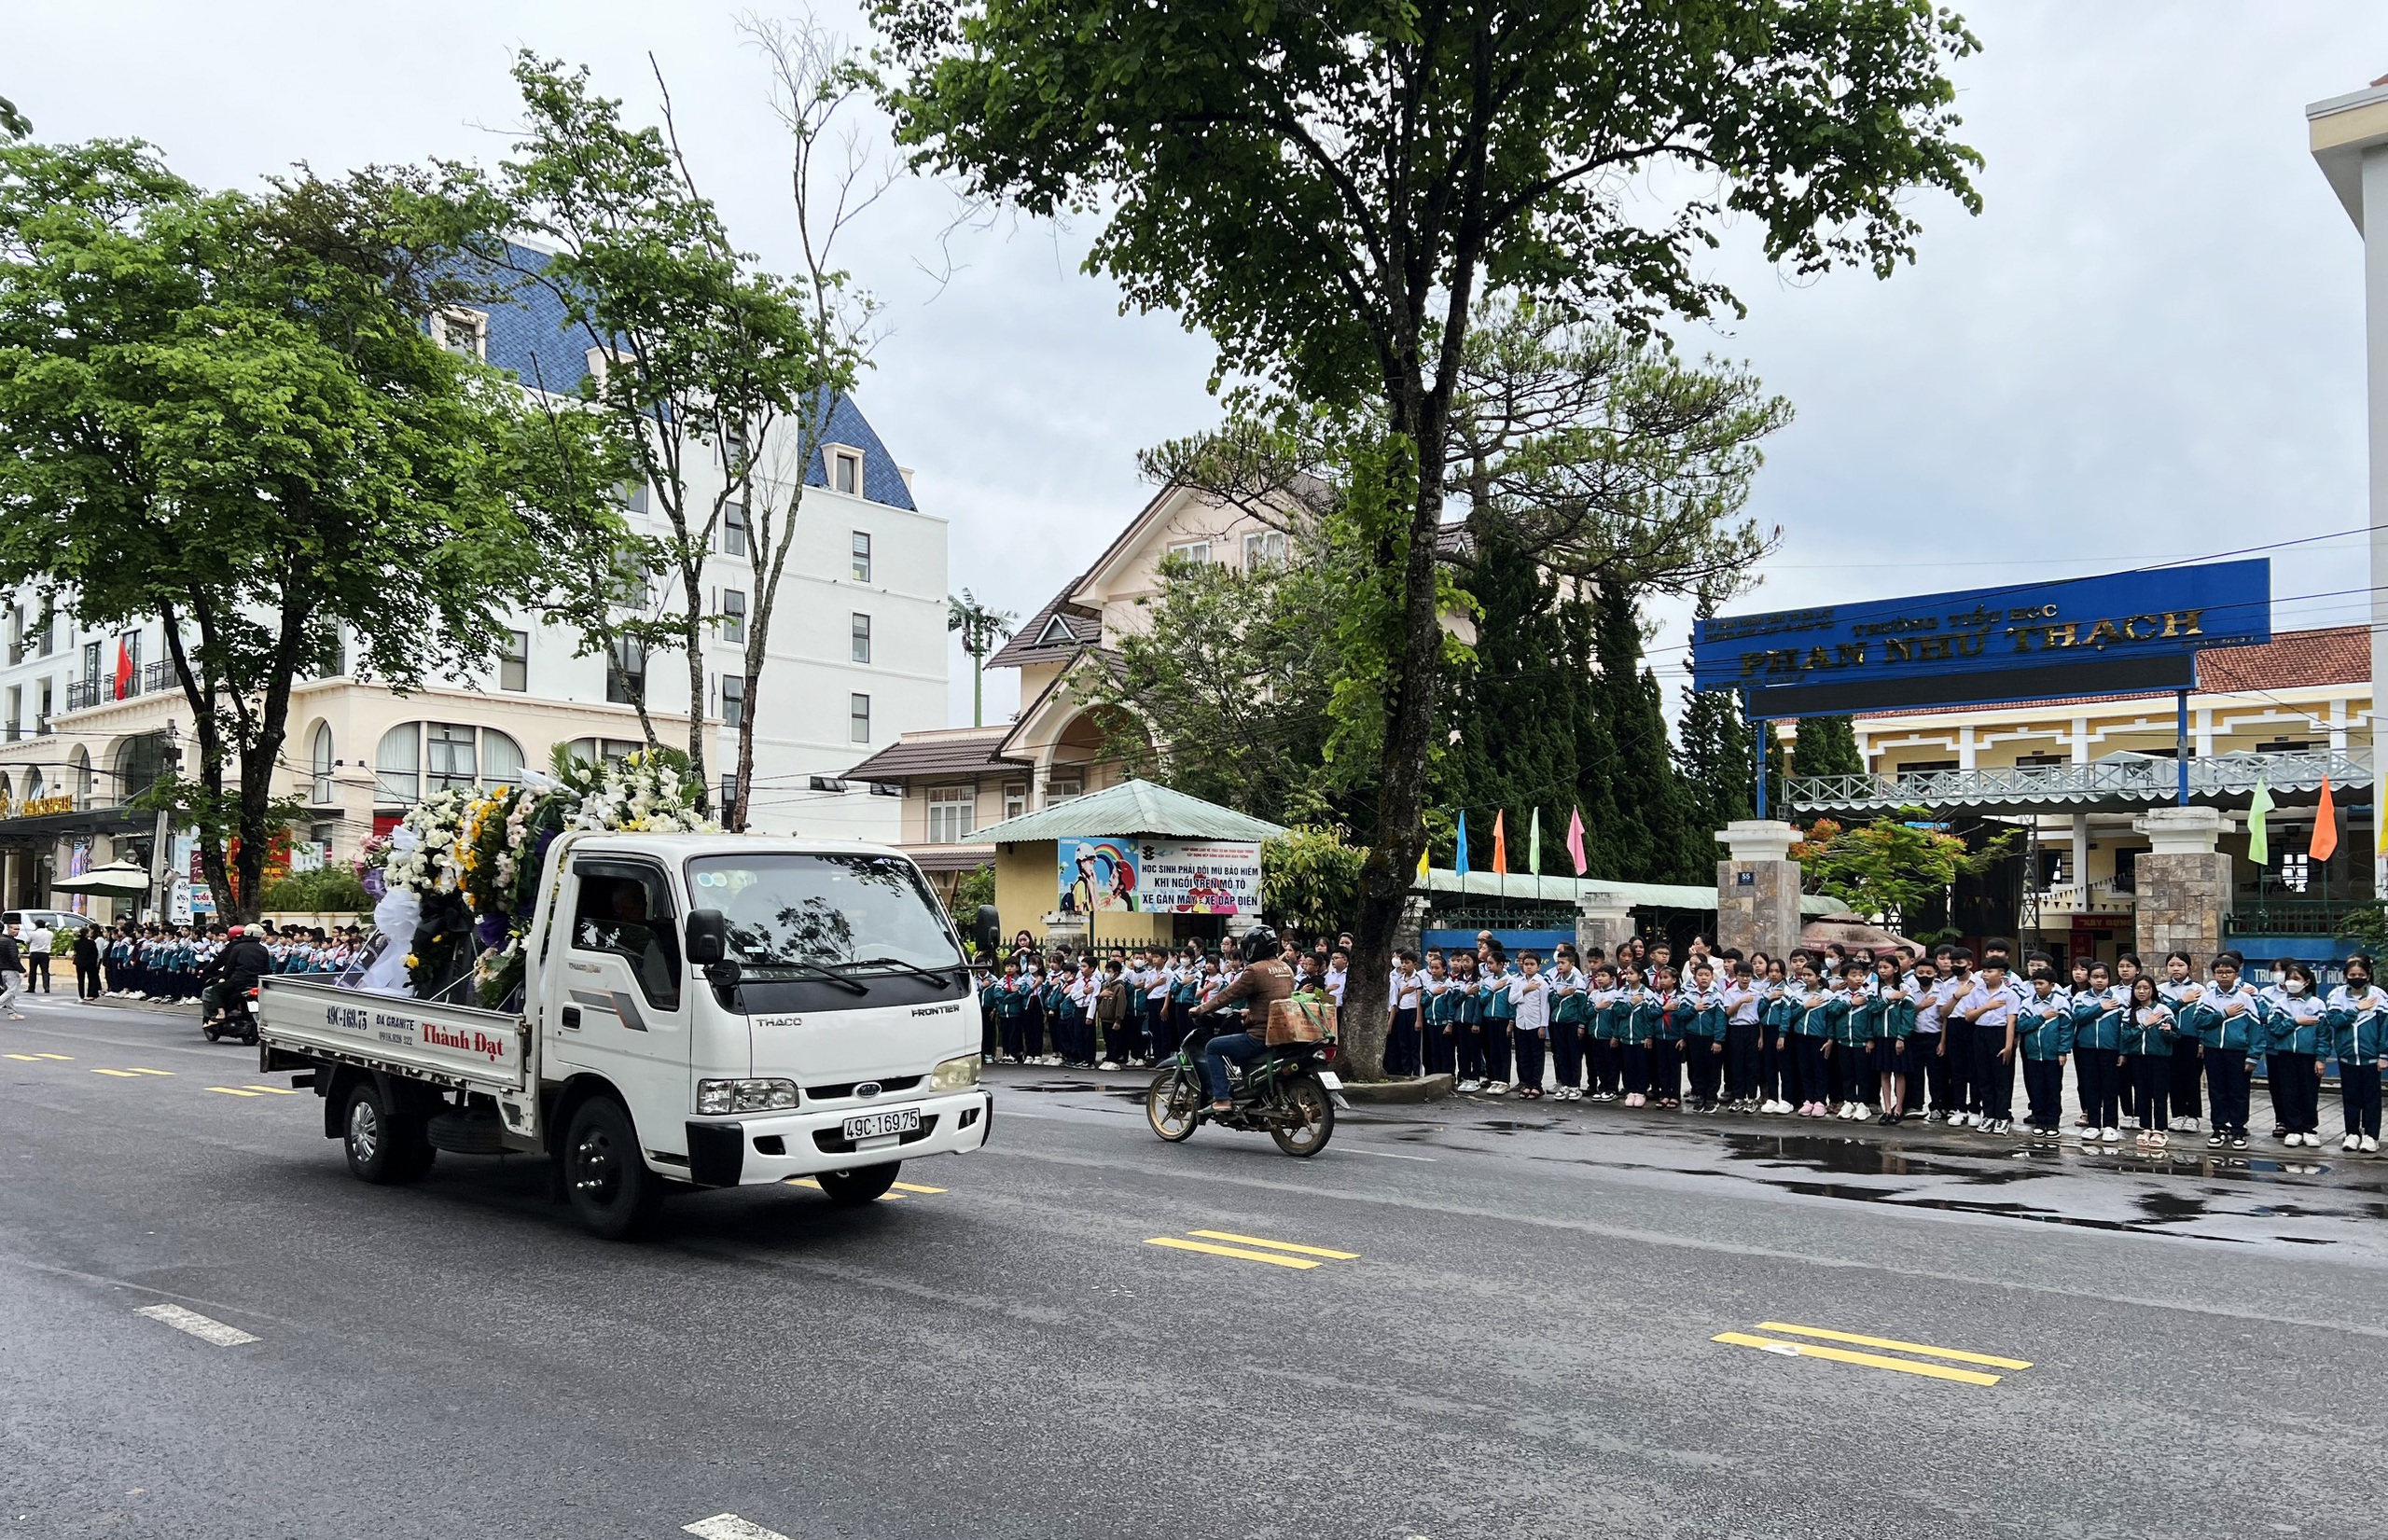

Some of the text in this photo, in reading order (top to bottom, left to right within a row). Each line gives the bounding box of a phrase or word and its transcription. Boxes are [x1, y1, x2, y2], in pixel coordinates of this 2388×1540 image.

[1852, 615, 1939, 637] TRƯỜNG
[1948, 604, 2003, 628] TIỂU
[2008, 604, 2058, 623] HỌC
[1740, 609, 2204, 675] PHAN NHƯ THẠCH
[1142, 864, 1157, 874] HỌC
[1159, 864, 1176, 874] SINH
[1178, 863, 1195, 875] PHẢI
[1155, 878, 1169, 888] KHI
[1220, 877, 1232, 889] MÔ
[1236, 878, 1246, 890] TÔ
[1143, 894, 1154, 904] XE
[1204, 895, 1215, 906] XE
[756, 1004, 960, 1027] THACO FRONTIER
[386, 1016, 415, 1031] GRANITE
[422, 1022, 470, 1050] Thành
[473, 1032, 504, 1062] Đạt
[846, 1110, 918, 1138] 49C-169.75
